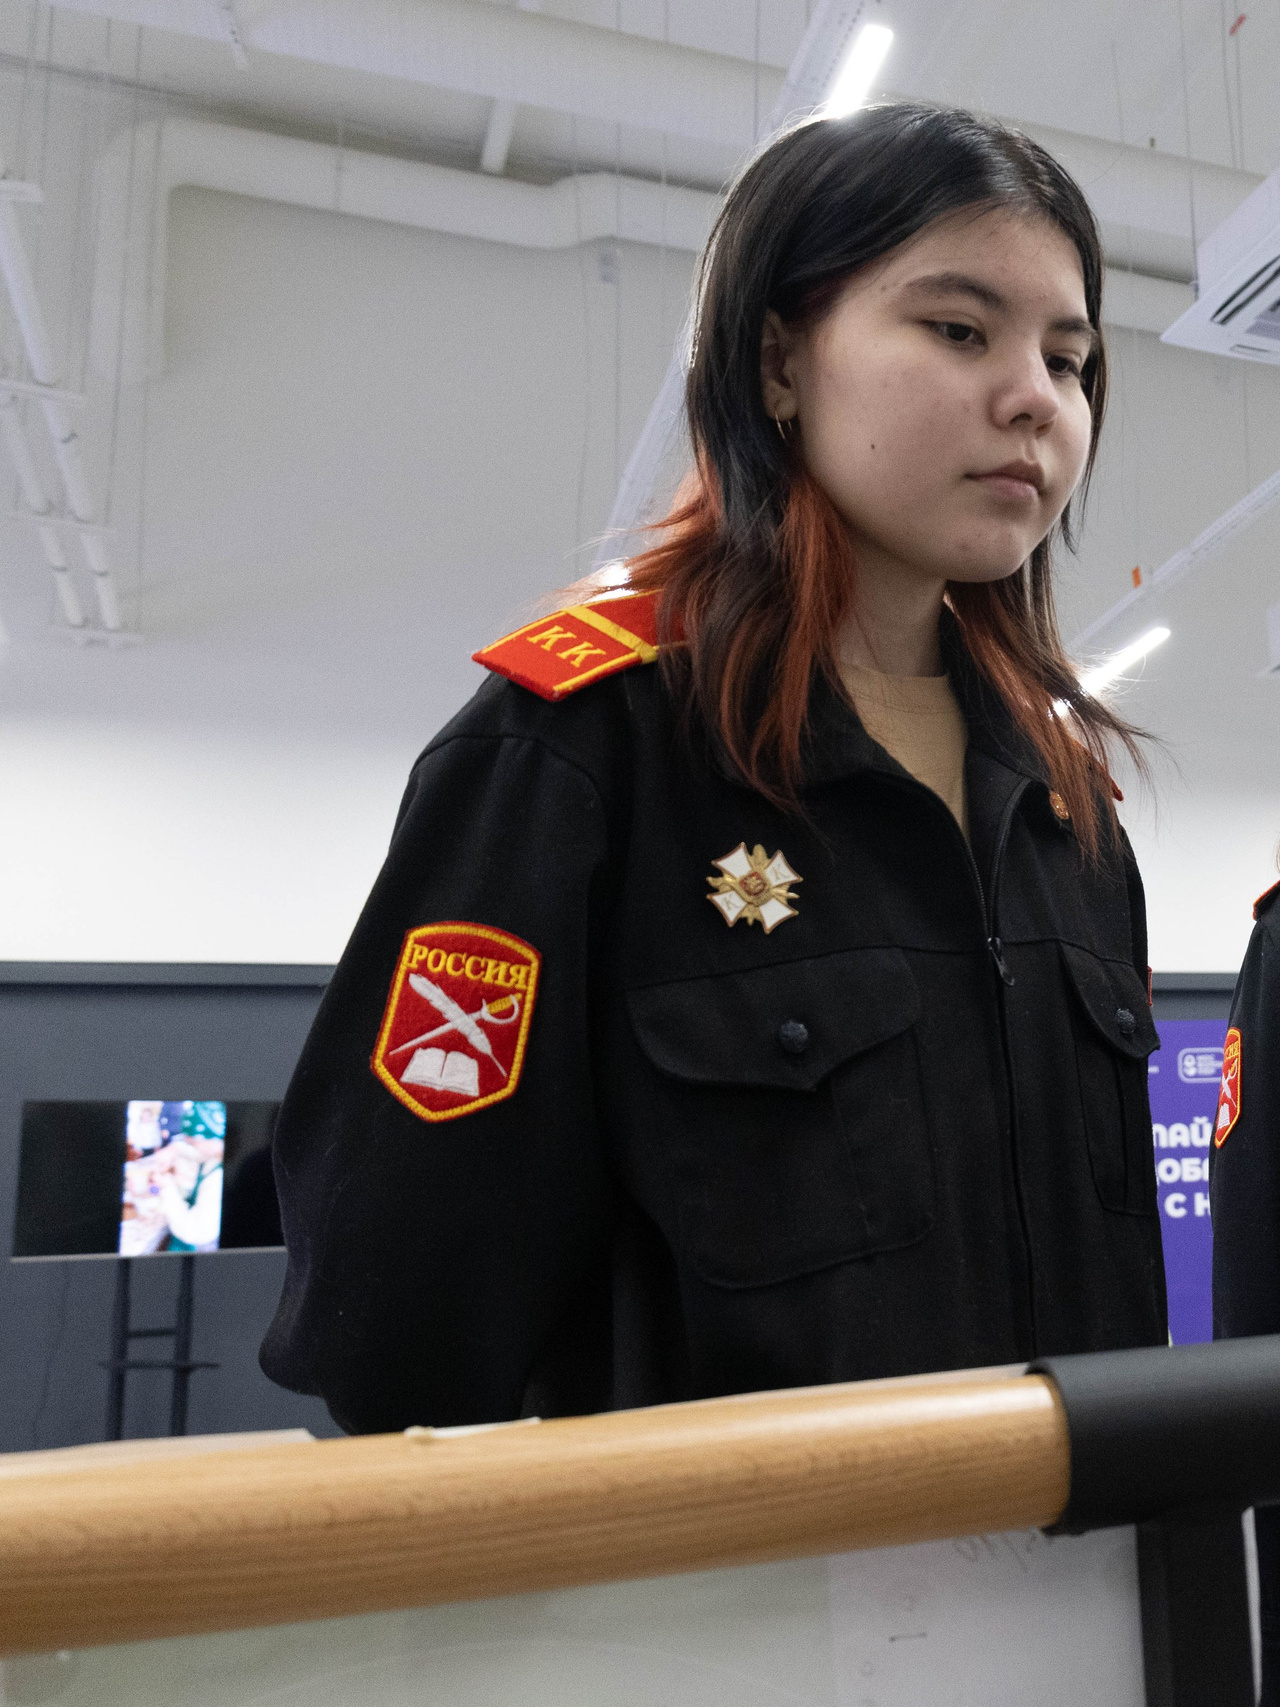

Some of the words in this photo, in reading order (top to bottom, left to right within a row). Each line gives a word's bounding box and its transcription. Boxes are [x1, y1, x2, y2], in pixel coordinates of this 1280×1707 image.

[526, 625, 607, 669] КК
[407, 943, 530, 990] РОССИЯ
[1164, 1192, 1188, 1218] С
